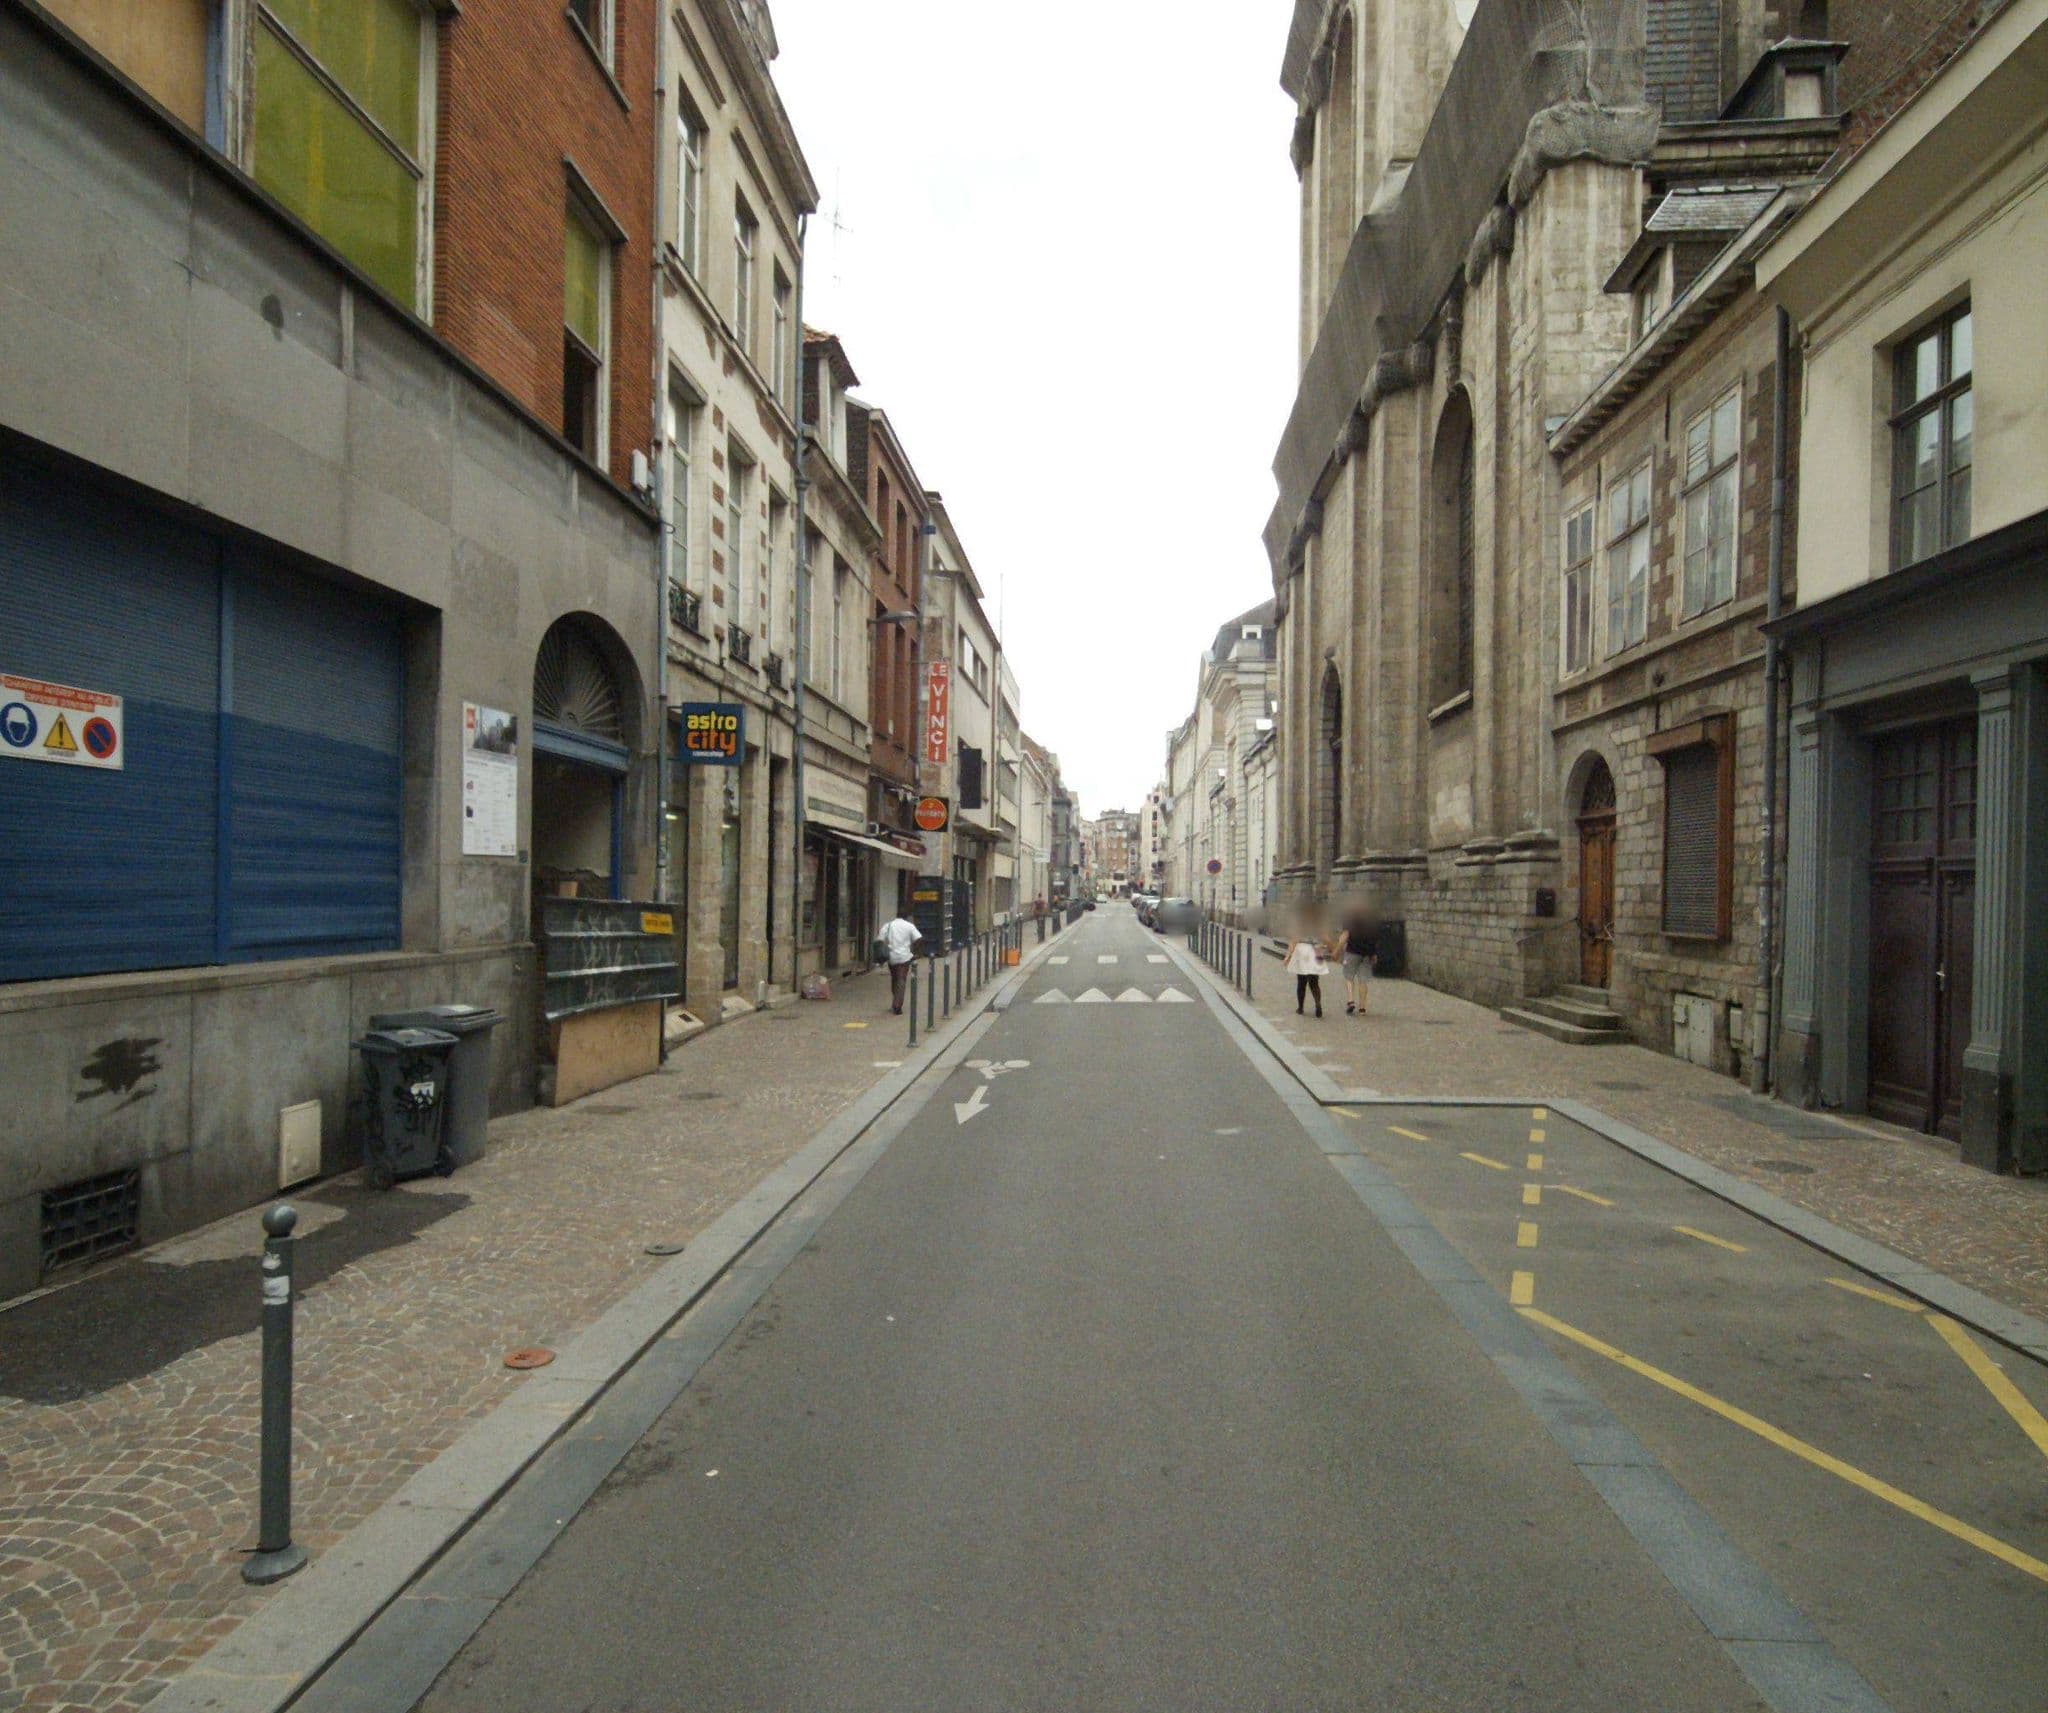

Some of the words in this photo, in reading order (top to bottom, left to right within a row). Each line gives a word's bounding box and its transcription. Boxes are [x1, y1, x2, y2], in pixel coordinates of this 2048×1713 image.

[931, 664, 947, 677] LE
[687, 710, 738, 730] astro
[930, 683, 946, 760] VINCI
[687, 730, 737, 757] city
